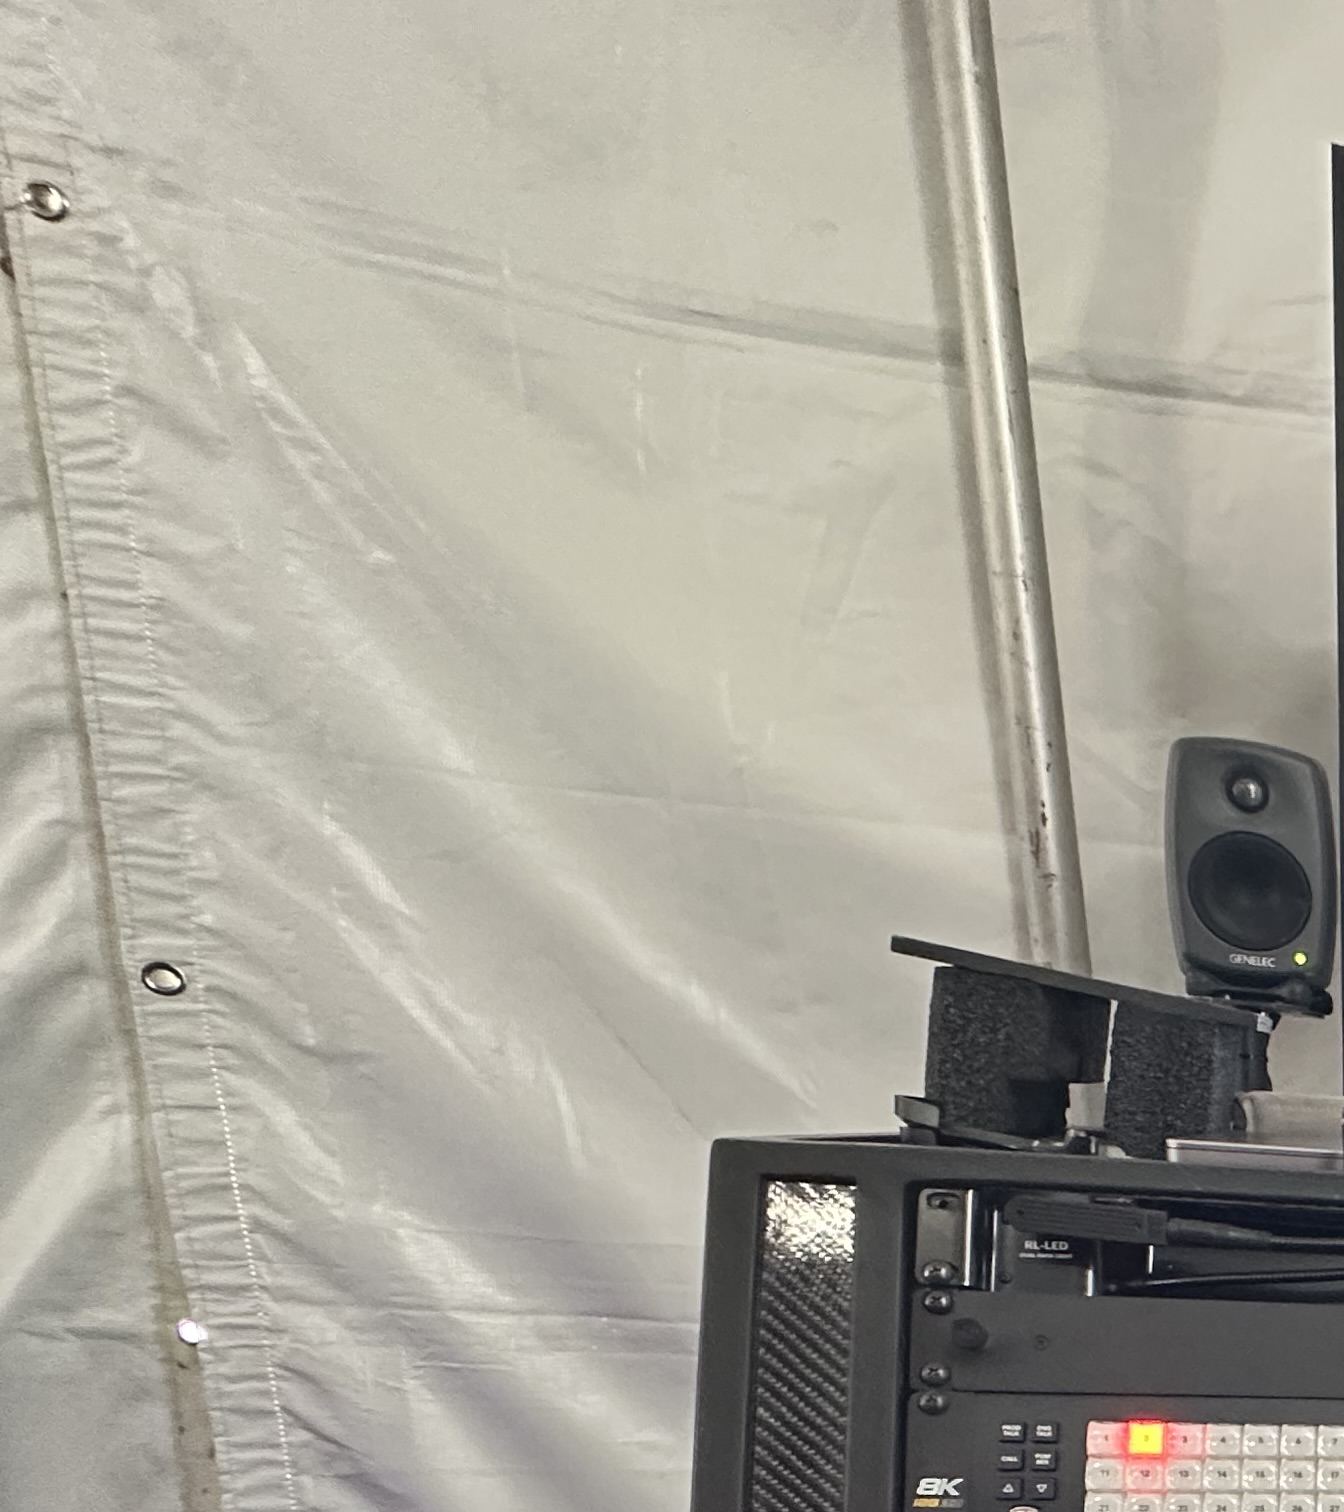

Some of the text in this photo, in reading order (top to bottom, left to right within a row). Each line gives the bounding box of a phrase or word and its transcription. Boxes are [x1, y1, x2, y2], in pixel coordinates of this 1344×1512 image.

[1229, 954, 1276, 968] GENELEC
[1024, 1240, 1068, 1250] RL-LED
[916, 1478, 964, 1496] 8K
